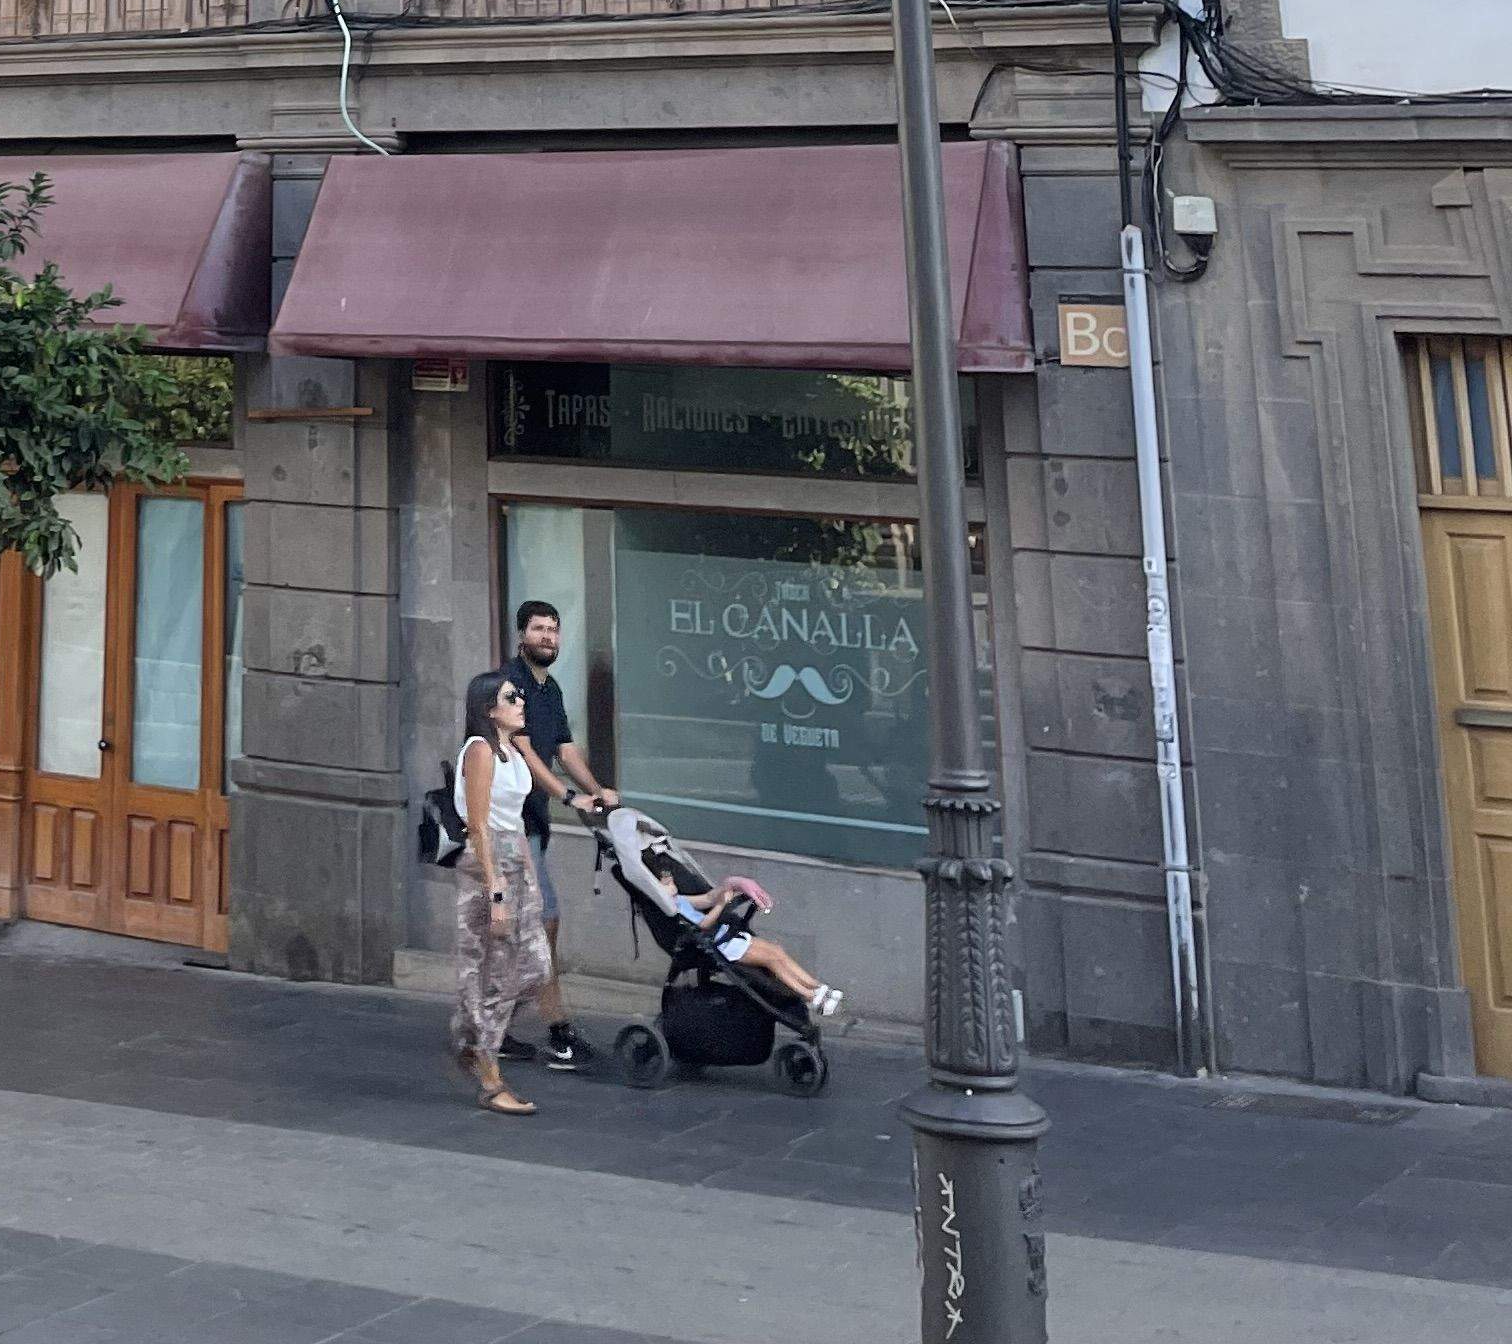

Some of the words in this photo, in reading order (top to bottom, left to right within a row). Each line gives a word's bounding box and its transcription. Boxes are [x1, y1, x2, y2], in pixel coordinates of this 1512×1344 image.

[669, 598, 715, 635] EL
[722, 602, 919, 656] CANALLA
[760, 722, 777, 743] DE
